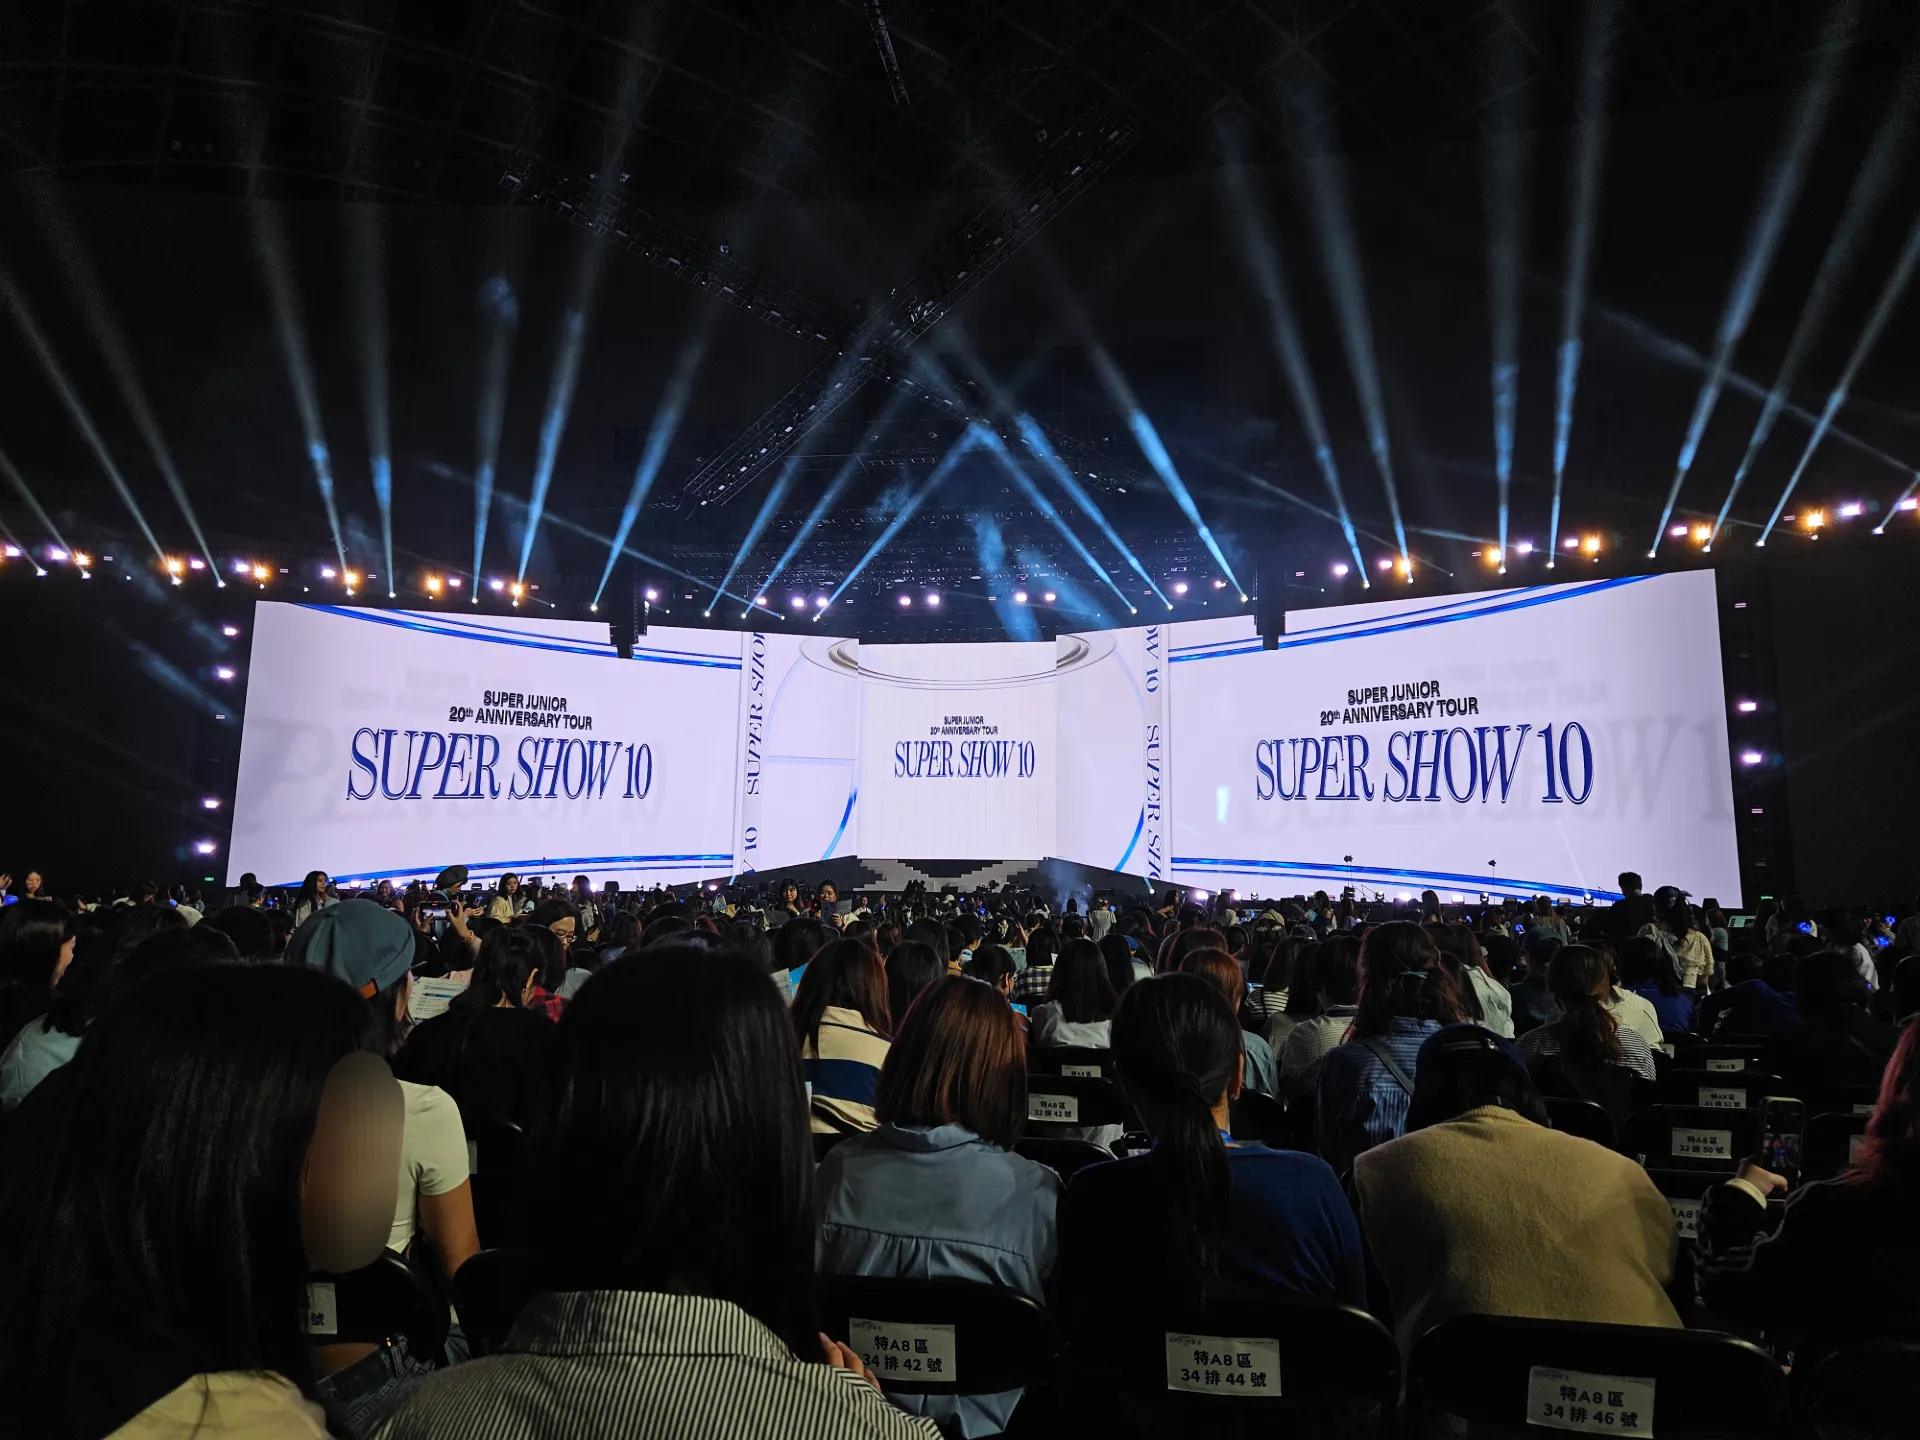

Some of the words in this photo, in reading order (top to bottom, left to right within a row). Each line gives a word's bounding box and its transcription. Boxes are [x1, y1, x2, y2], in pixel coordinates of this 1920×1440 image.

[483, 690, 524, 709] SUPER
[525, 694, 567, 712] JUNIOR
[1347, 686, 1388, 705] SUPER
[1390, 680, 1440, 701] JUNIOR
[449, 706, 473, 722] 20th
[475, 708, 561, 728] ANNIVERSARY
[562, 714, 592, 731] TOUR
[944, 716, 962, 725] SUPER
[963, 716, 984, 725] JUNIOR
[1320, 710, 1340, 726] 20th
[1342, 701, 1434, 725] ANNIVERSARY
[1436, 697, 1479, 717] TOUR
[941, 726, 981, 735] ANNIVERSARY
[982, 726, 998, 735] TOUR
[346, 727, 501, 800] SUPER
[508, 736, 623, 800] SHOW
[622, 743, 653, 800] 10
[746, 703, 763, 795] SUPER
[894, 740, 953, 778] SUPER
[956, 740, 1016, 778] SHOW
[1017, 740, 1035, 778] 10
[1255, 733, 1375, 801] SUPER
[1383, 724, 1531, 802] SHOW
[1537, 722, 1594, 805] 10
[1146, 725, 1161, 822] SUPER
